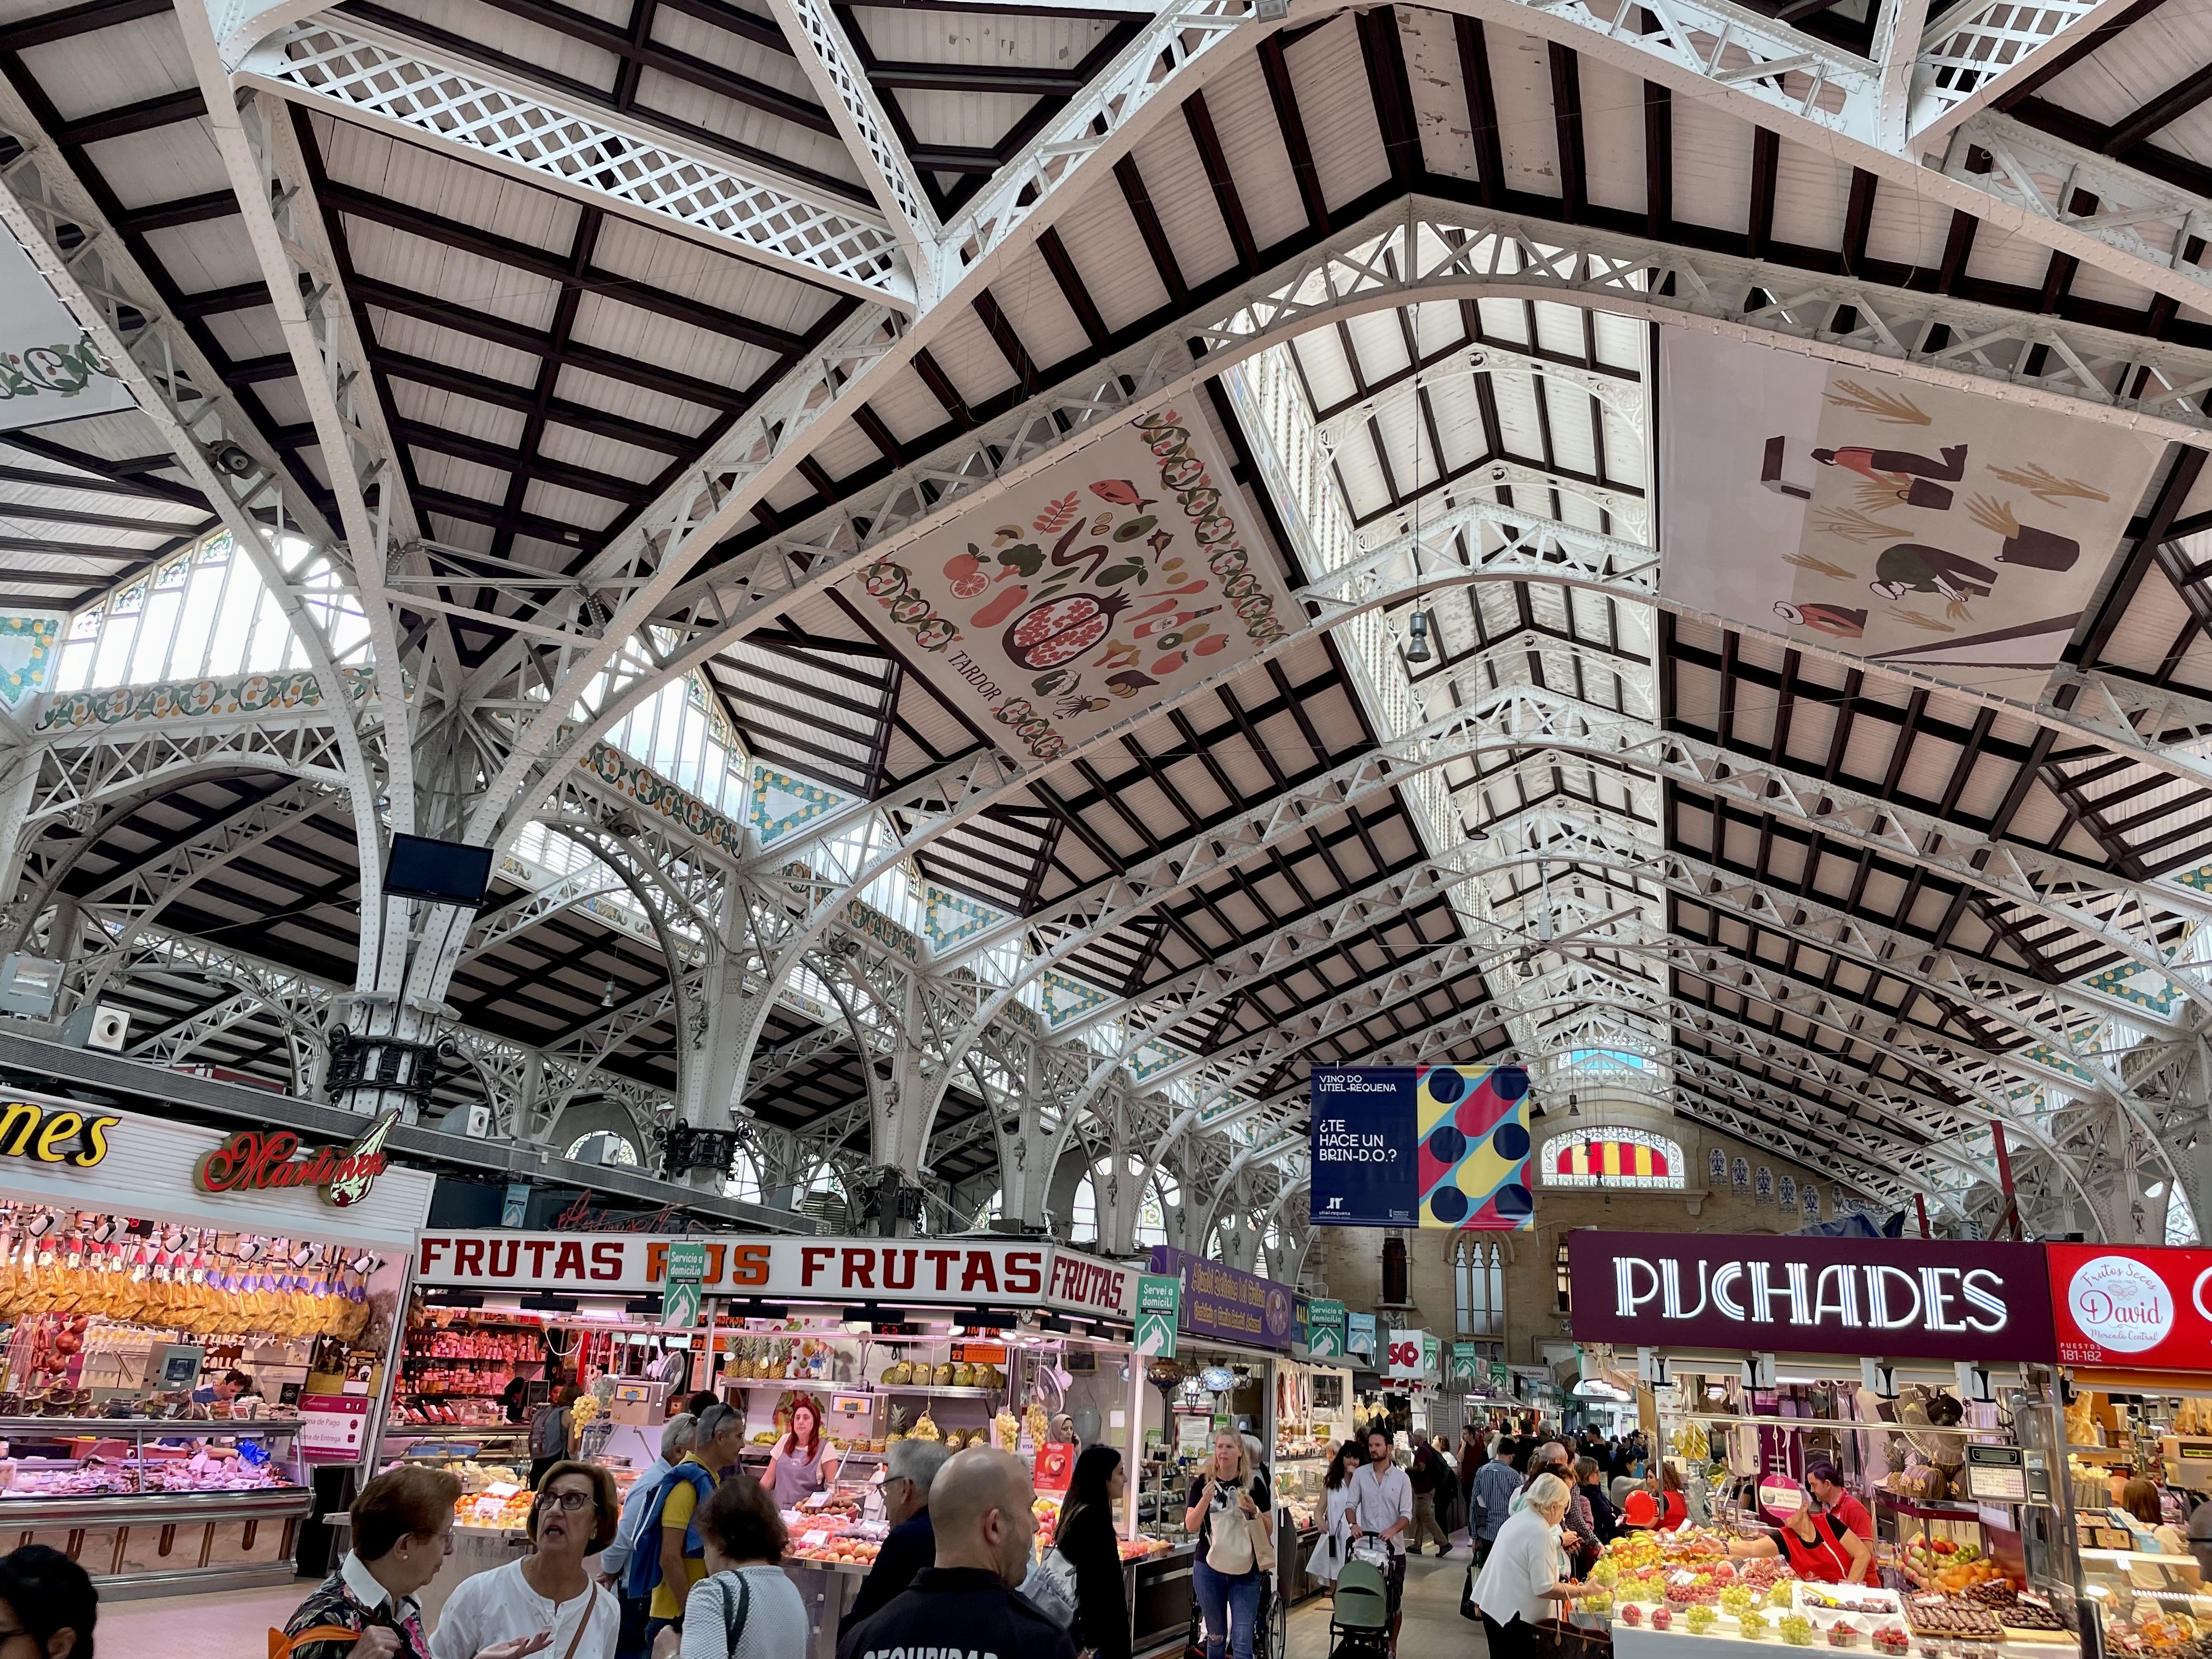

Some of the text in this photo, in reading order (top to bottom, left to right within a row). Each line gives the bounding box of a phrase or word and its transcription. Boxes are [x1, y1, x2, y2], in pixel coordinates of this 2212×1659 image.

[948, 650, 1002, 702] TARDOR
[1319, 1075, 1345, 1083] VINO
[1319, 1084, 1396, 1092] UTIEL-REQUENA
[1319, 1120, 1345, 1132] ¿TE
[1319, 1135, 1384, 1147] HACE UN
[1319, 1149, 1397, 1163] BRIN-D.O.?
[671, 1251, 697, 1263] Servicio
[420, 1238, 624, 1280] FRUTAS
[801, 1248, 1041, 1294] FRUTAS
[670, 1265, 701, 1275] domicilio
[1049, 1255, 1125, 1308] FRUTAS
[2080, 1263, 2157, 1290] Frutos Secos
[1143, 1284, 1166, 1295] Servei
[1612, 1257, 2007, 1332] PUCHADES
[1143, 1296, 1172, 1307] domicili
[2080, 1290, 2163, 1324] David
[1311, 1306, 1336, 1314] Servicio
[1312, 1314, 1341, 1322] domicilio
[2090, 1329, 2158, 1341] Mercado Central
[2061, 1350, 2102, 1362] 181-182
[325, 1419, 340, 1427] Pago
[321, 1435, 341, 1443] Entrega
